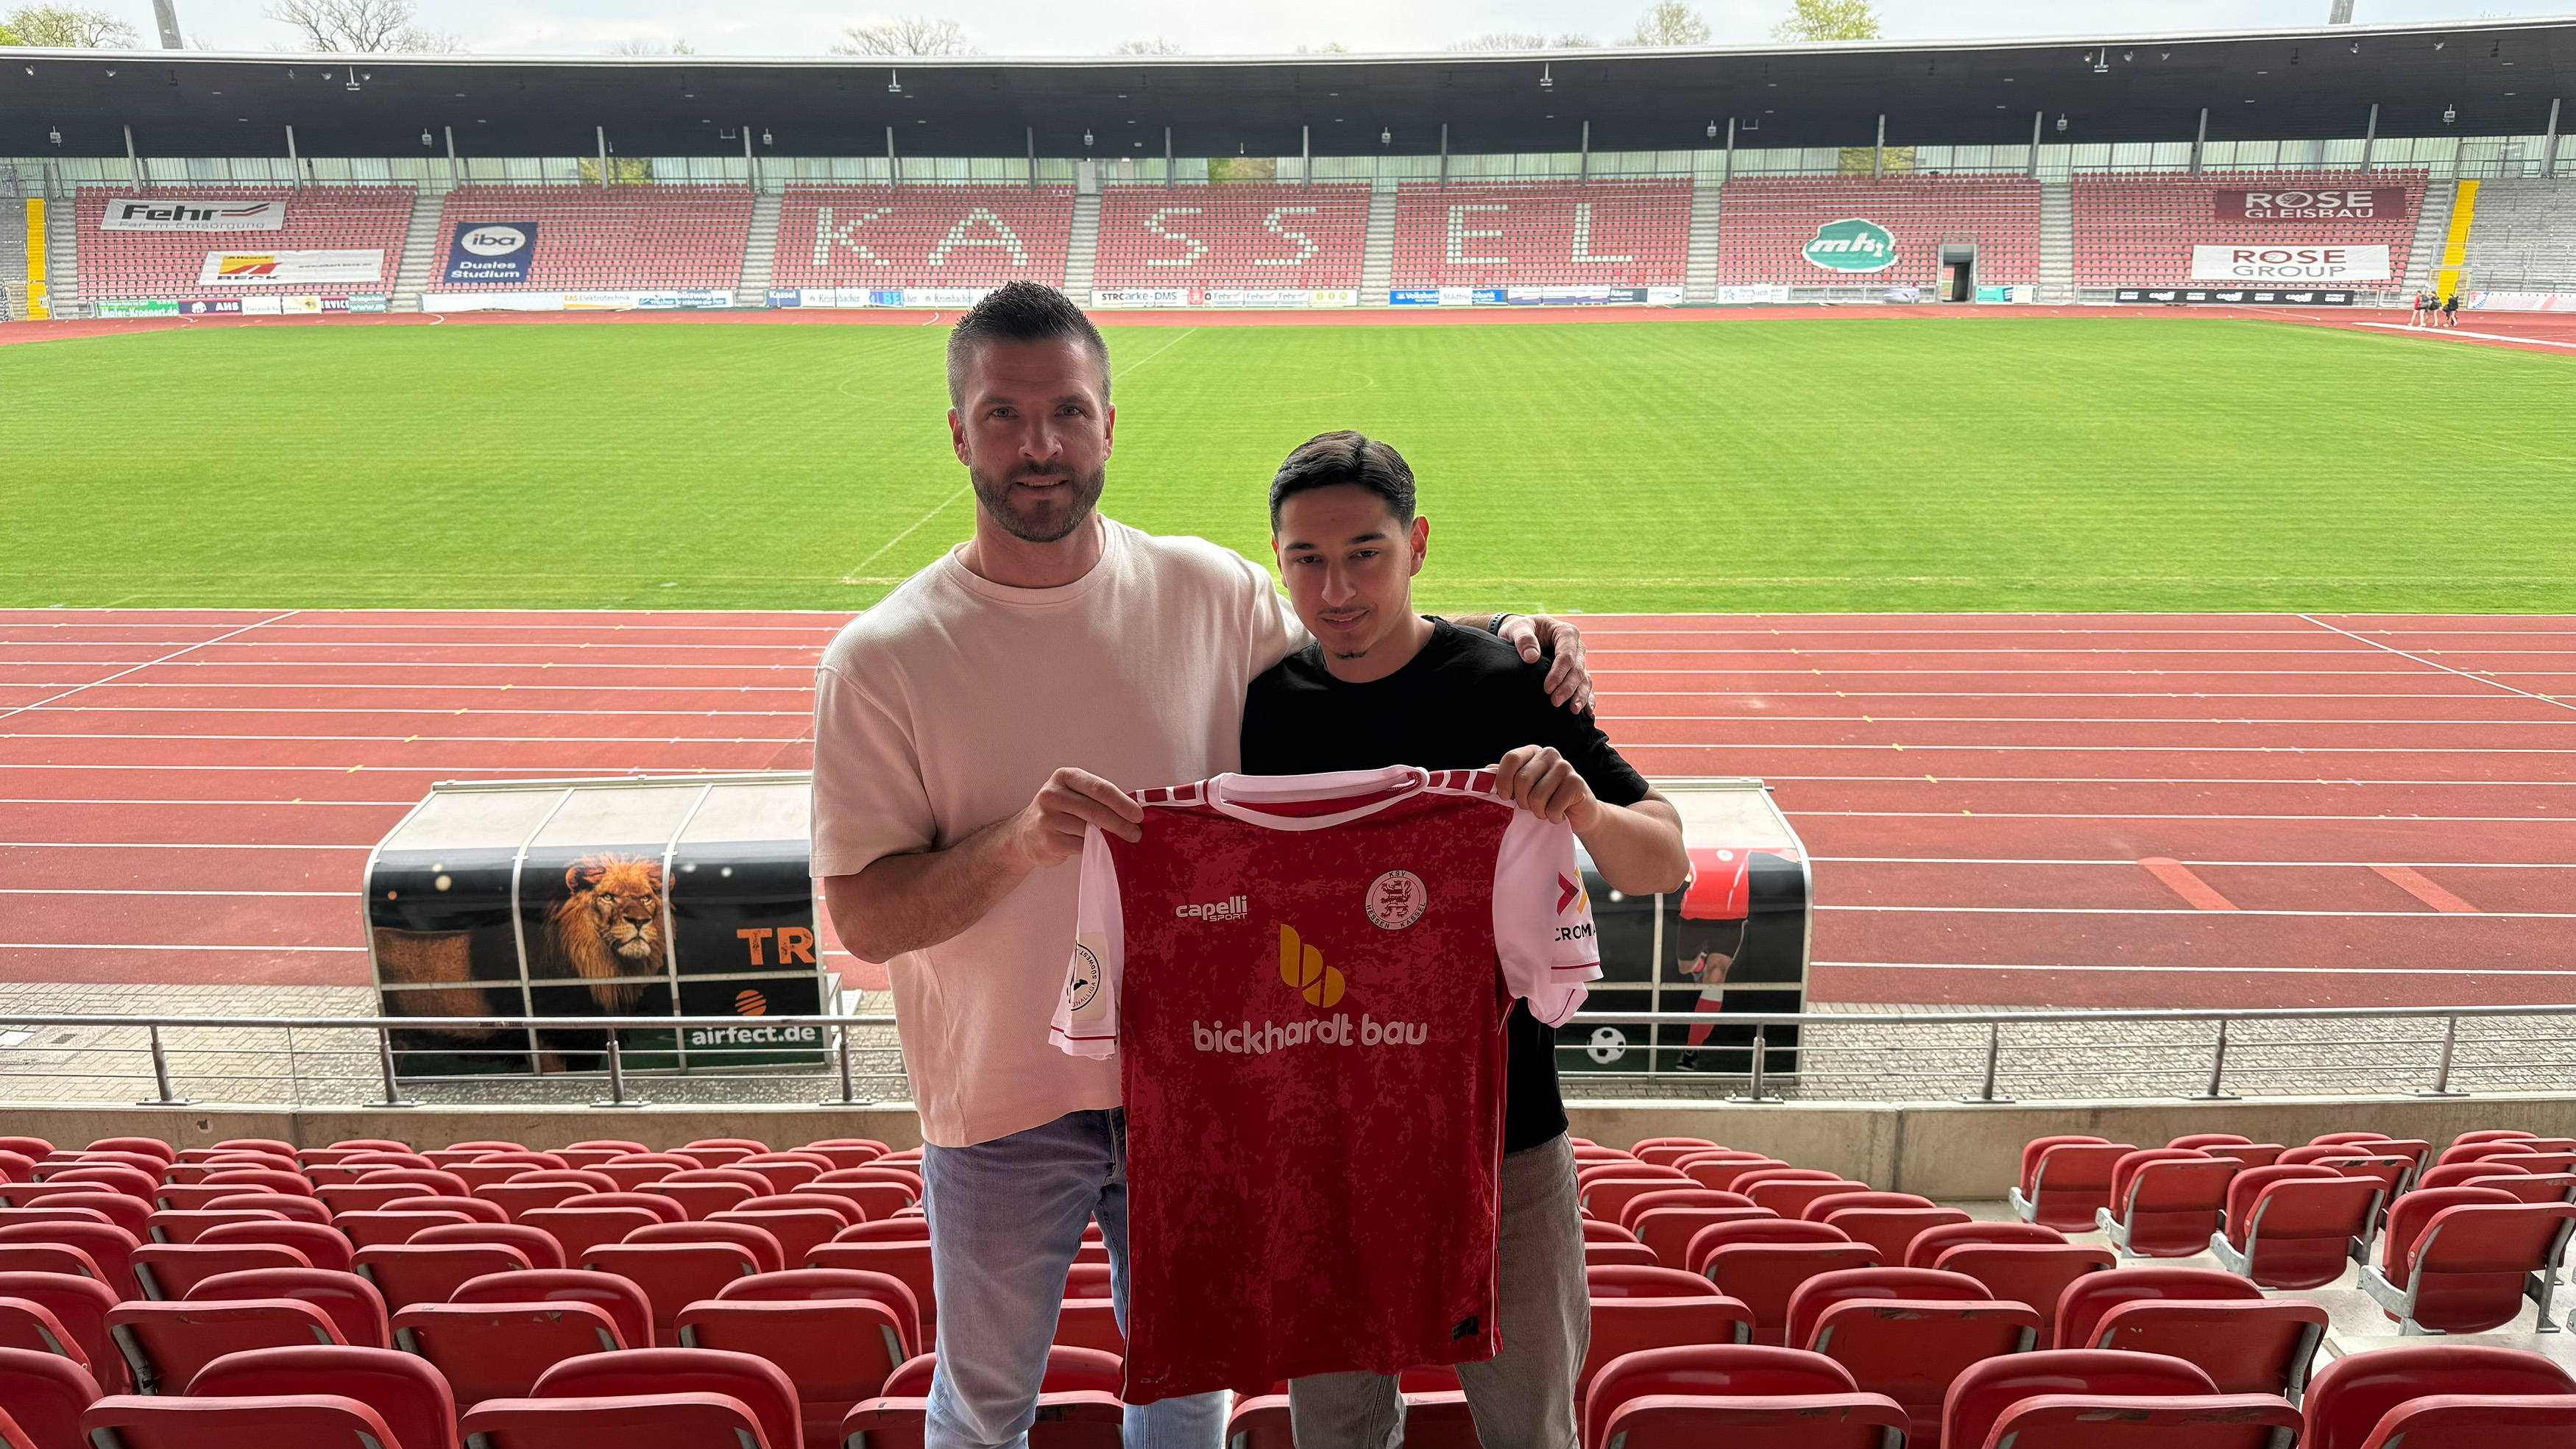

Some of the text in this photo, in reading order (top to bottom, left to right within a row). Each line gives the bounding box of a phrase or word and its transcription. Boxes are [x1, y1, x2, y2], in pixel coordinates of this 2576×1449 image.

[2246, 191, 2373, 208] ROSE
[121, 205, 219, 221] Fehr
[2245, 208, 2373, 219] GLEISBAU
[176, 222, 265, 230] Entsorgung
[473, 233, 516, 245] iba
[2233, 249, 2346, 263] ROSE
[460, 261, 516, 269] Duales
[450, 270, 520, 278] Studium
[2233, 266, 2346, 277] GROUP
[216, 302, 239, 311] AHS
[1176, 896, 1248, 921] capelli
[1209, 913, 1248, 921] SPORT
[1366, 903, 1426, 929] HESSEN KASSEL
[692, 1026, 815, 1045] airfect.de
[1193, 1013, 1427, 1055] bickhardt bau
